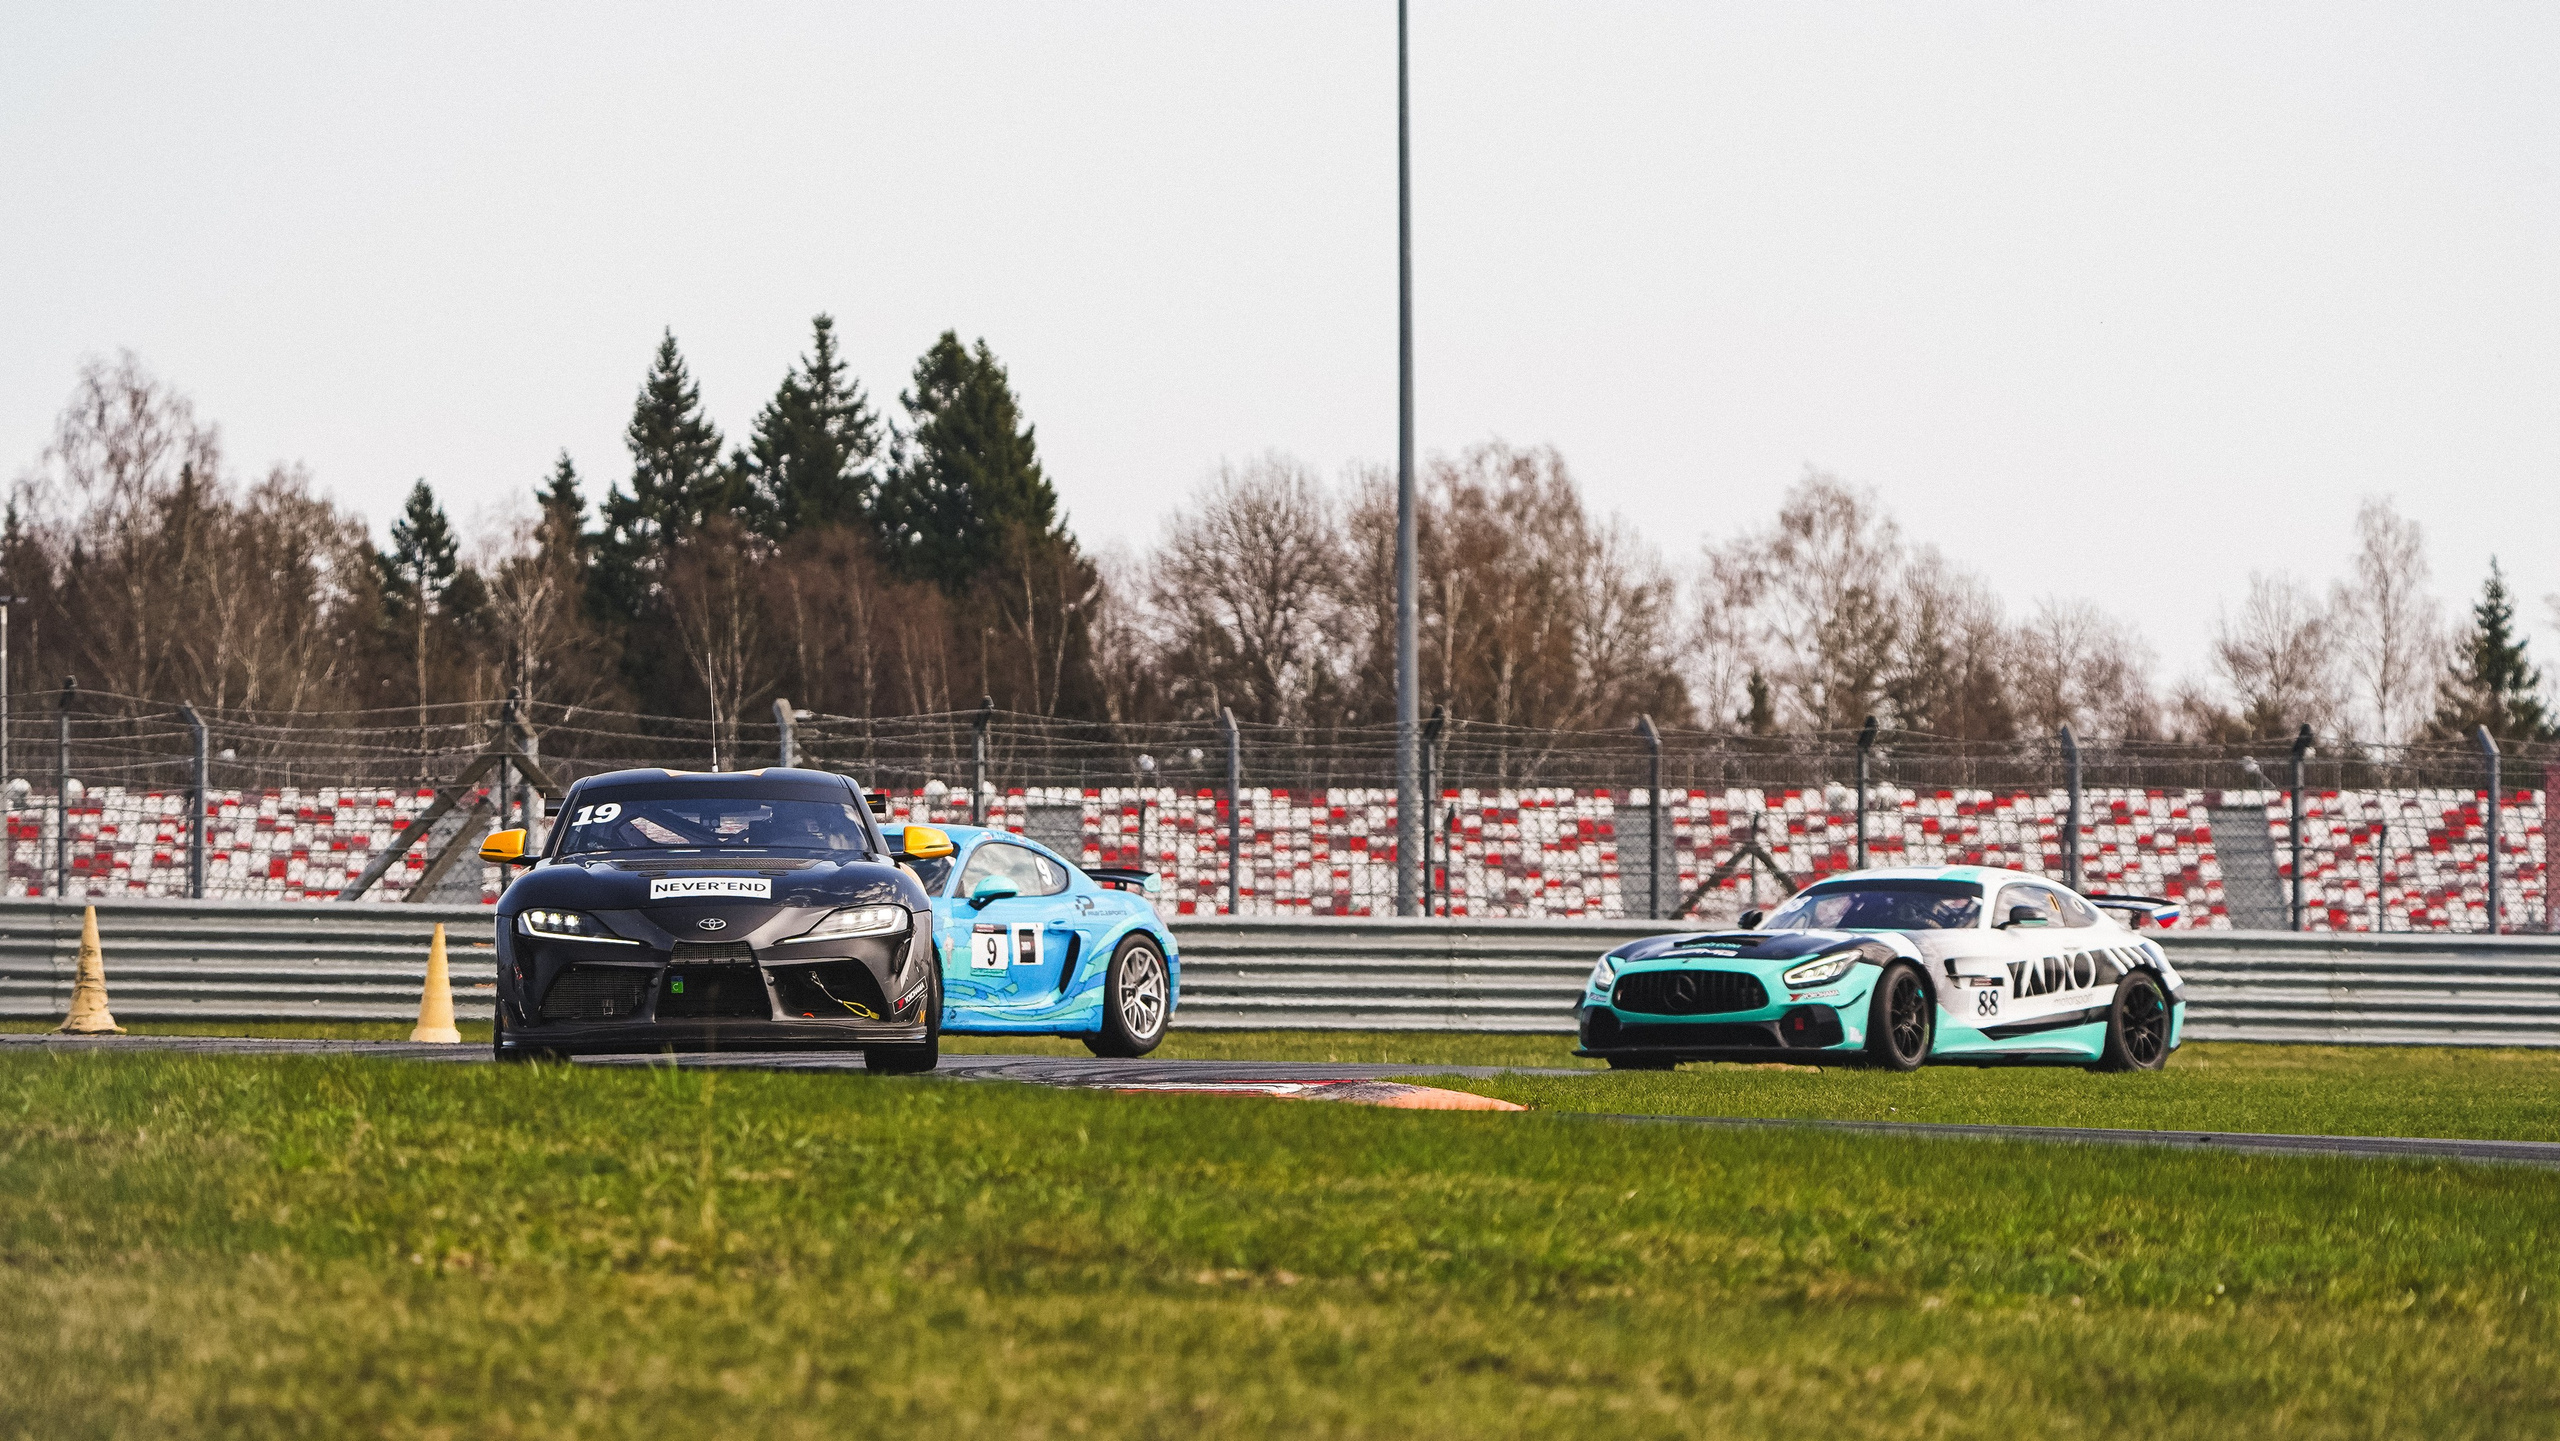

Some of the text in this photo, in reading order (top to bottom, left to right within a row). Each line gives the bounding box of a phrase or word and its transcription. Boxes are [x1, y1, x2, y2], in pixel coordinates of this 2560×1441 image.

[572, 803, 621, 826] 19
[1036, 856, 1053, 886] 9
[987, 938, 997, 966] 9
[1977, 989, 1998, 1016] 88
